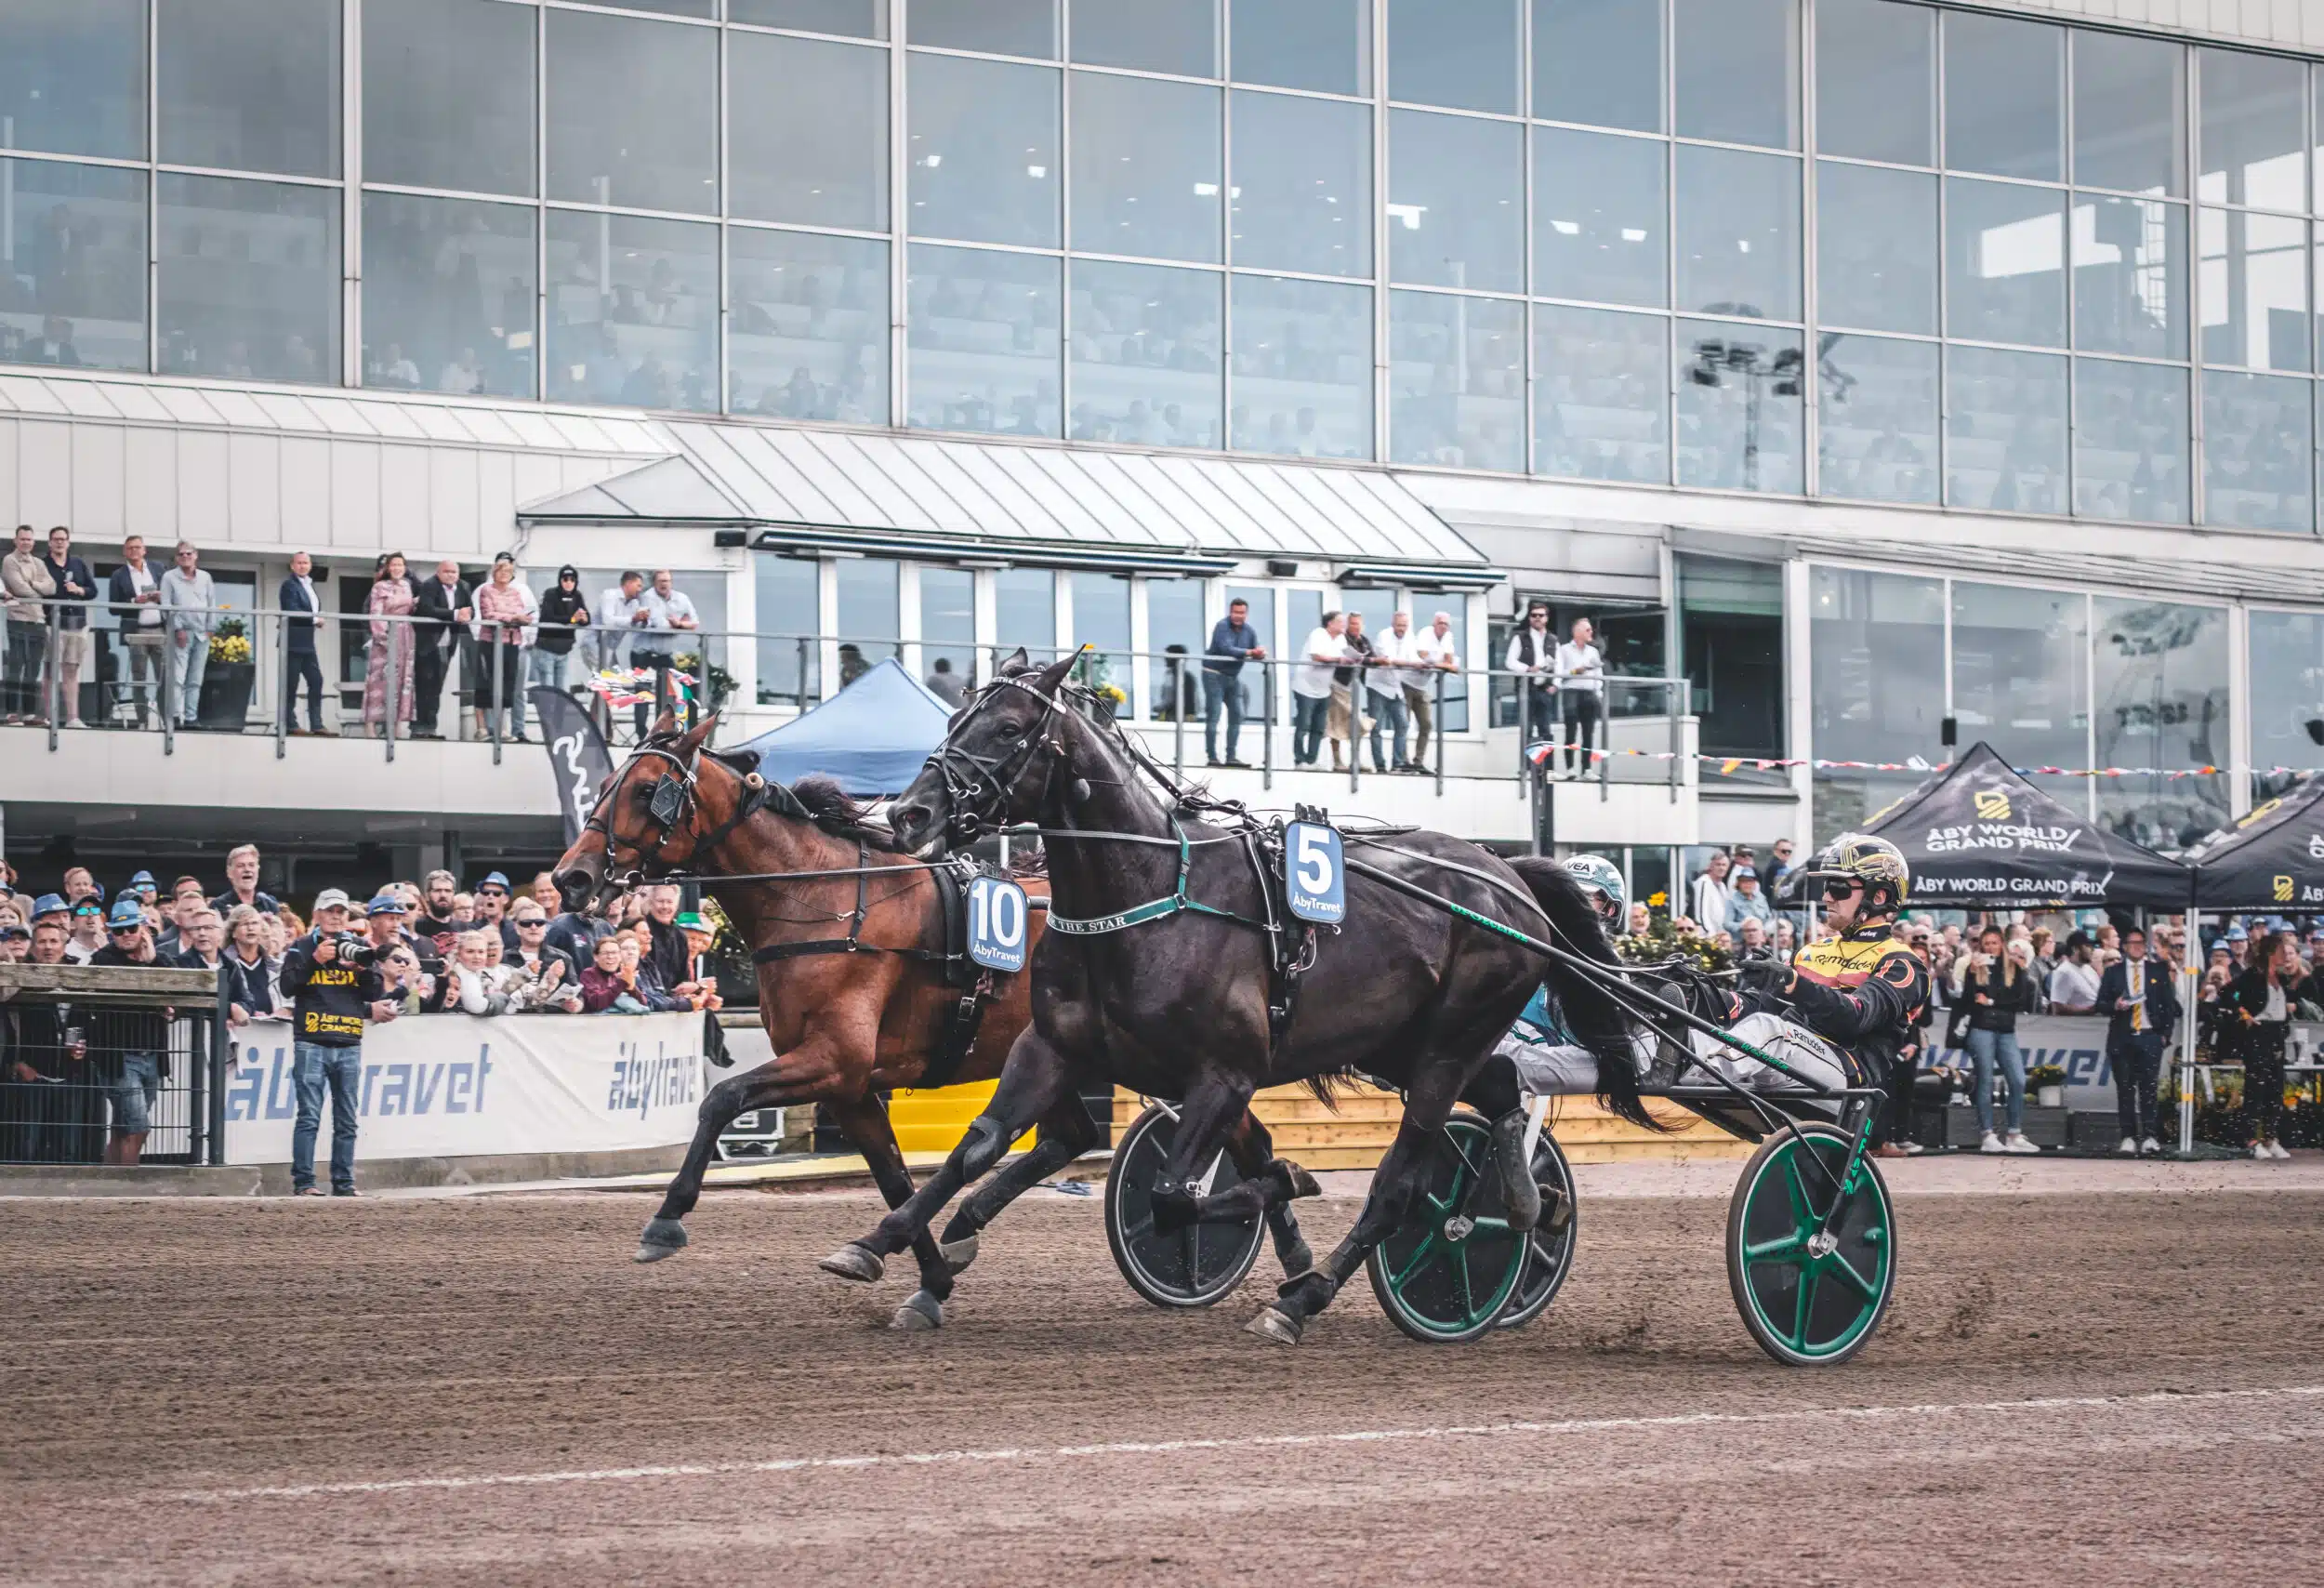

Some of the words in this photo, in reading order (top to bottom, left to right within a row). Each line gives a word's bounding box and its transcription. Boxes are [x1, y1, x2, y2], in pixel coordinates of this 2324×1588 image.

[1926, 825, 1973, 842] ÅBY
[1978, 824, 2068, 840] WORLD
[1926, 836, 2014, 852] GRAND
[2019, 829, 2081, 852] PRIX
[1297, 826, 1332, 894] 5
[1915, 876, 1946, 893] ÅBY
[1949, 878, 2007, 893] WORLD
[2010, 879, 2068, 893] GRAND
[2071, 871, 2114, 895] PRIX
[2302, 884, 2324, 901] ÅB
[972, 880, 1023, 947] 10
[1293, 892, 1341, 913] ÅbyTravet
[1059, 920, 1085, 933] THE
[1089, 916, 1126, 932] STAR
[973, 940, 1021, 963] ÅbyTravet
[224, 1043, 493, 1121] åbravet
